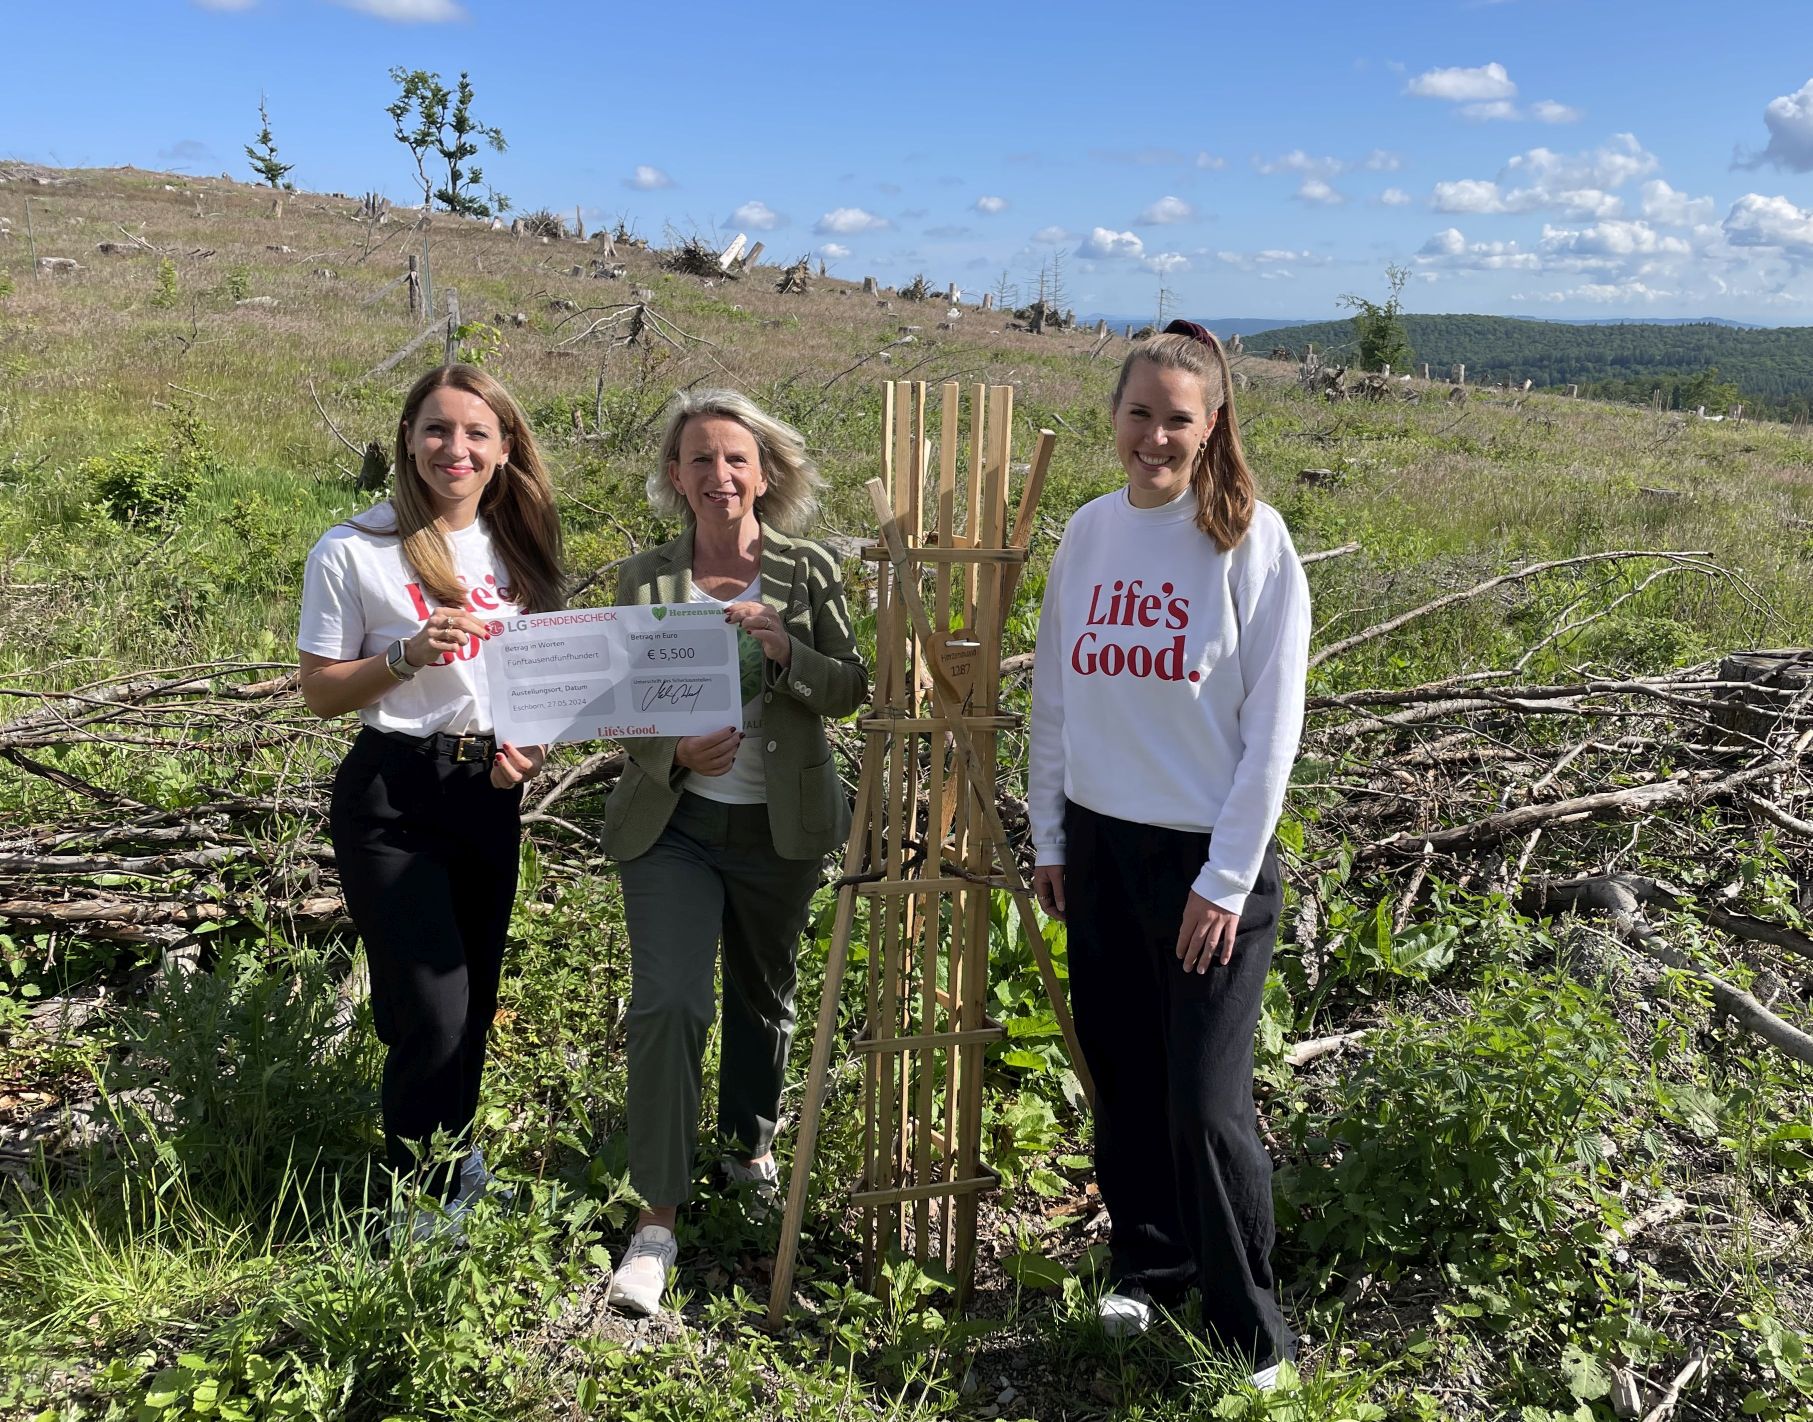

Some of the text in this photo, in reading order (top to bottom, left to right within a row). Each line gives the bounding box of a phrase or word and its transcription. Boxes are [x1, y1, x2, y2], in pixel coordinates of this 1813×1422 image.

[1086, 580, 1189, 630] Life's
[507, 612, 617, 632] LG SPENDENSCHECK
[505, 644, 529, 653] Betrag
[538, 641, 565, 649] Worten
[647, 647, 695, 661] € 5,500
[1071, 632, 1200, 682] Good.
[565, 684, 588, 692] Datum
[547, 698, 587, 708] 27.05.2024
[597, 724, 659, 737] Life's Good.
